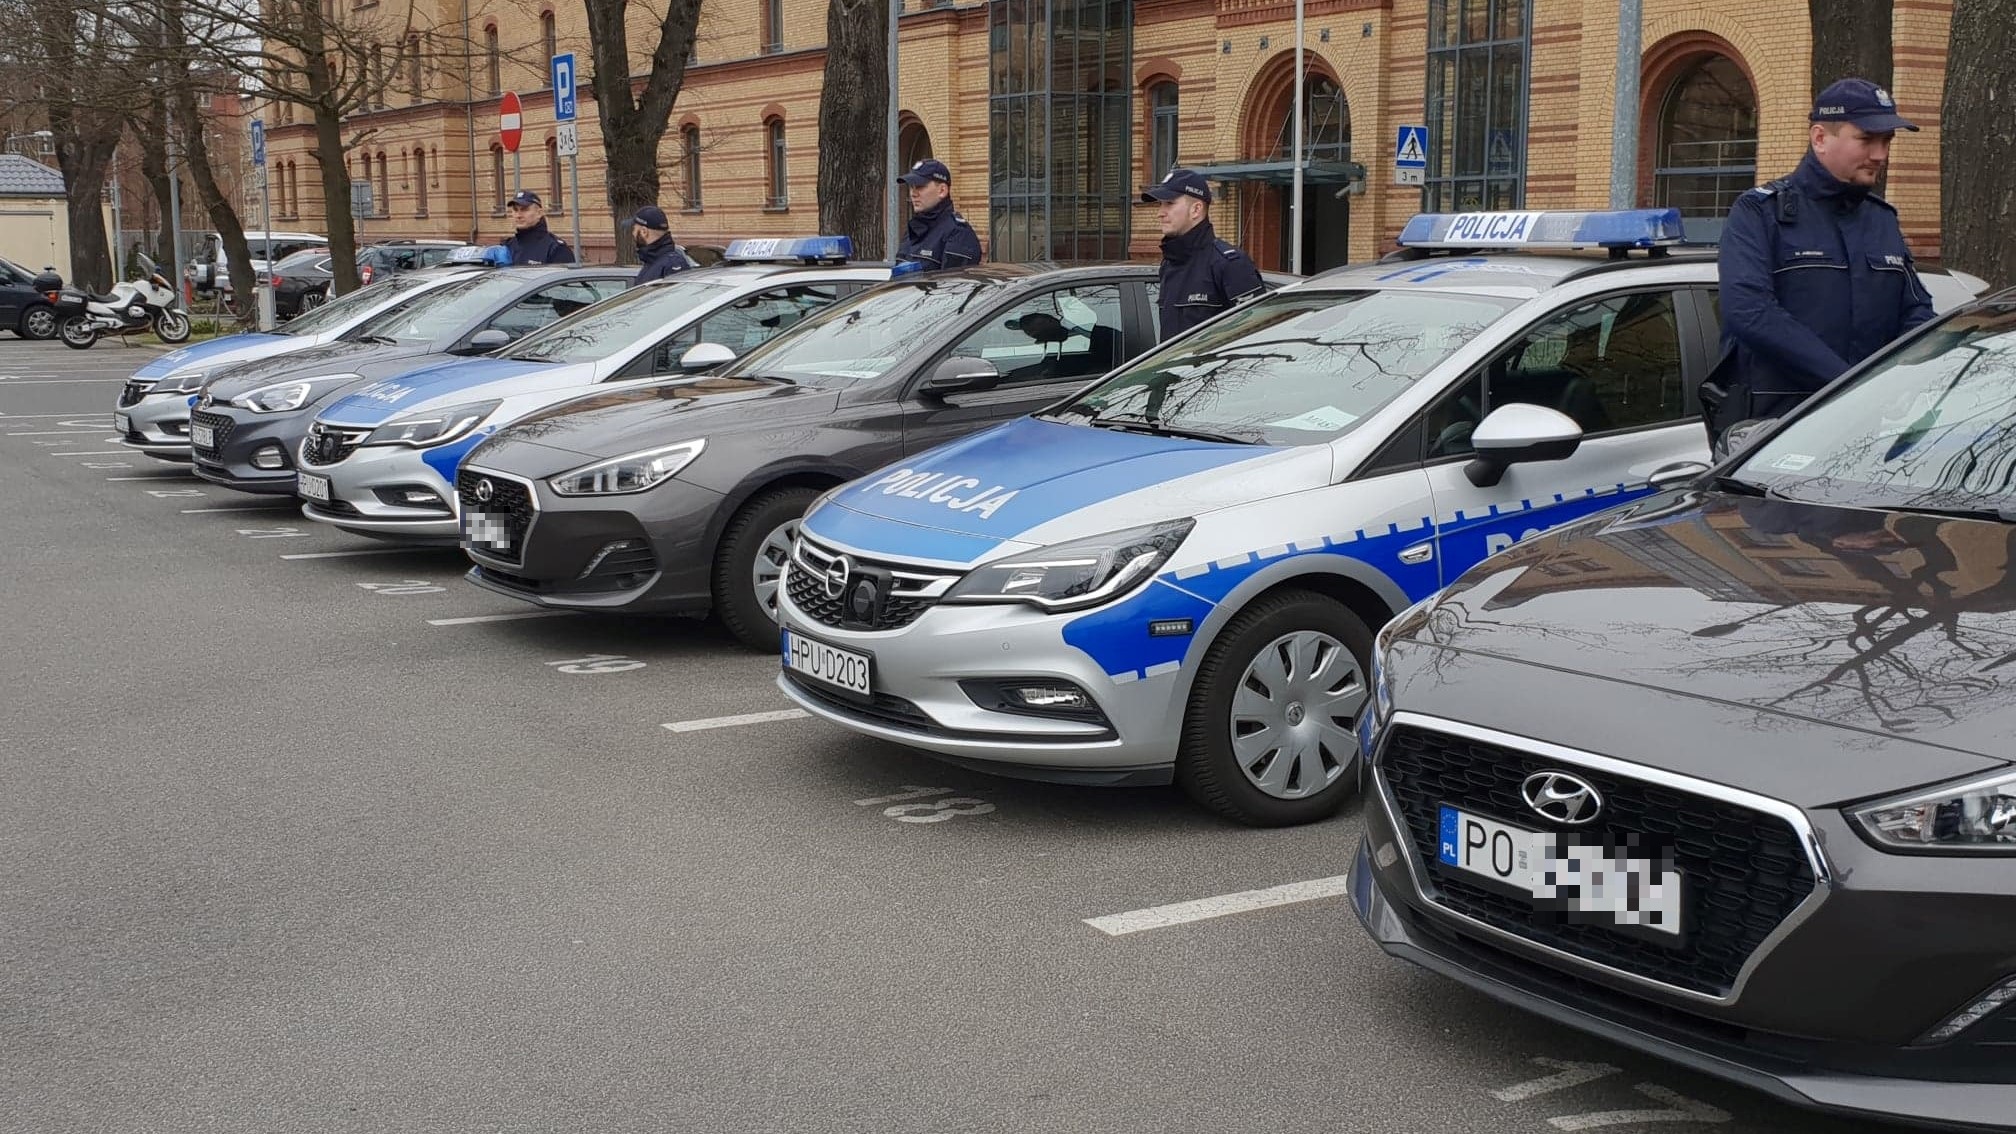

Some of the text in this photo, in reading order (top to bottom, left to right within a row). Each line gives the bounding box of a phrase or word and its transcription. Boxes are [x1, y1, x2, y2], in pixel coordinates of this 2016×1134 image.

[556, 62, 570, 113] P
[1819, 106, 1845, 115] POLICJA
[1401, 171, 1418, 183] 3 m
[1185, 186, 1204, 196] POLICJA
[1449, 215, 1529, 239] POLICJA
[741, 240, 777, 257] POLICJA
[1188, 293, 1208, 302] POLICJA
[862, 468, 1021, 519] POLICJA
[853, 785, 997, 824] 18
[1442, 819, 1514, 878] PL PO
